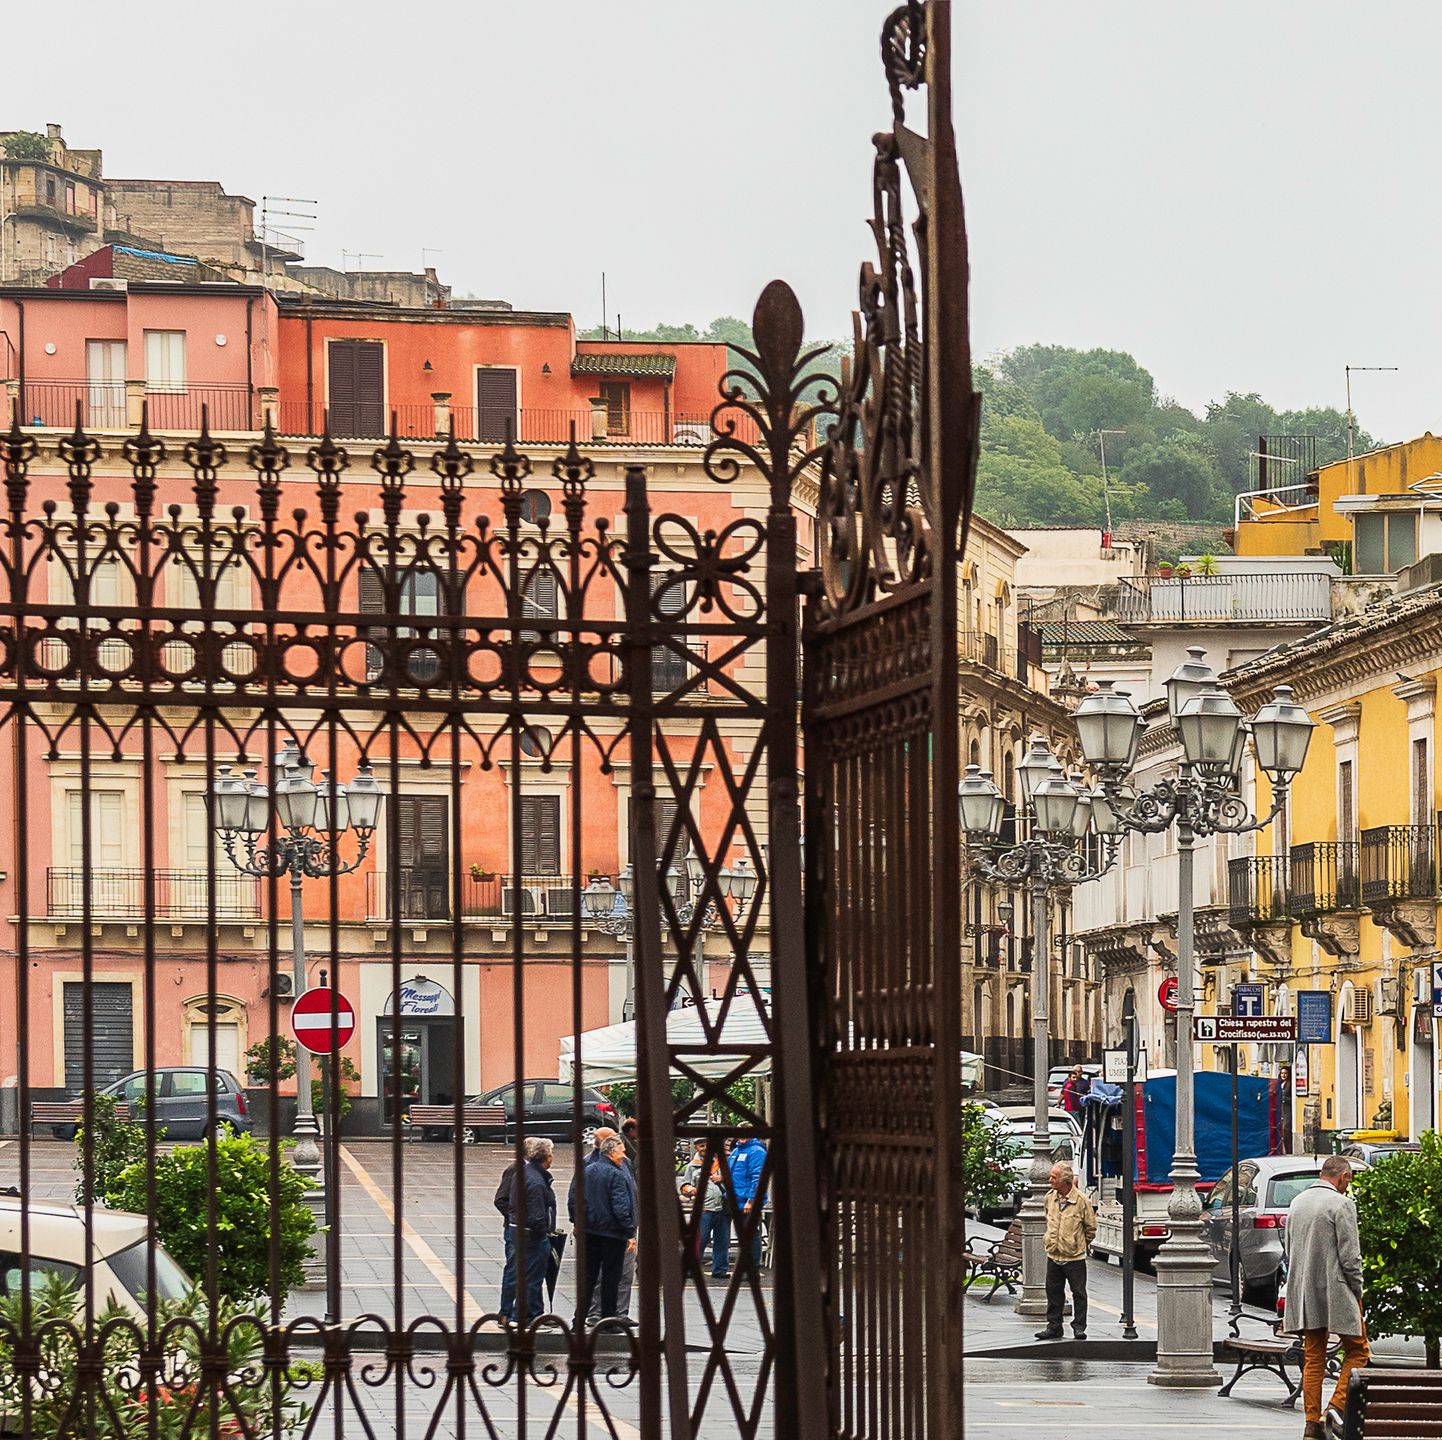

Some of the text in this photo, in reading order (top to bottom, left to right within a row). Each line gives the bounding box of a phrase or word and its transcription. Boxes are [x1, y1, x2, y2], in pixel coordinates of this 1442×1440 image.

[1219, 1018, 1292, 1029] Chiesa rupestre del
